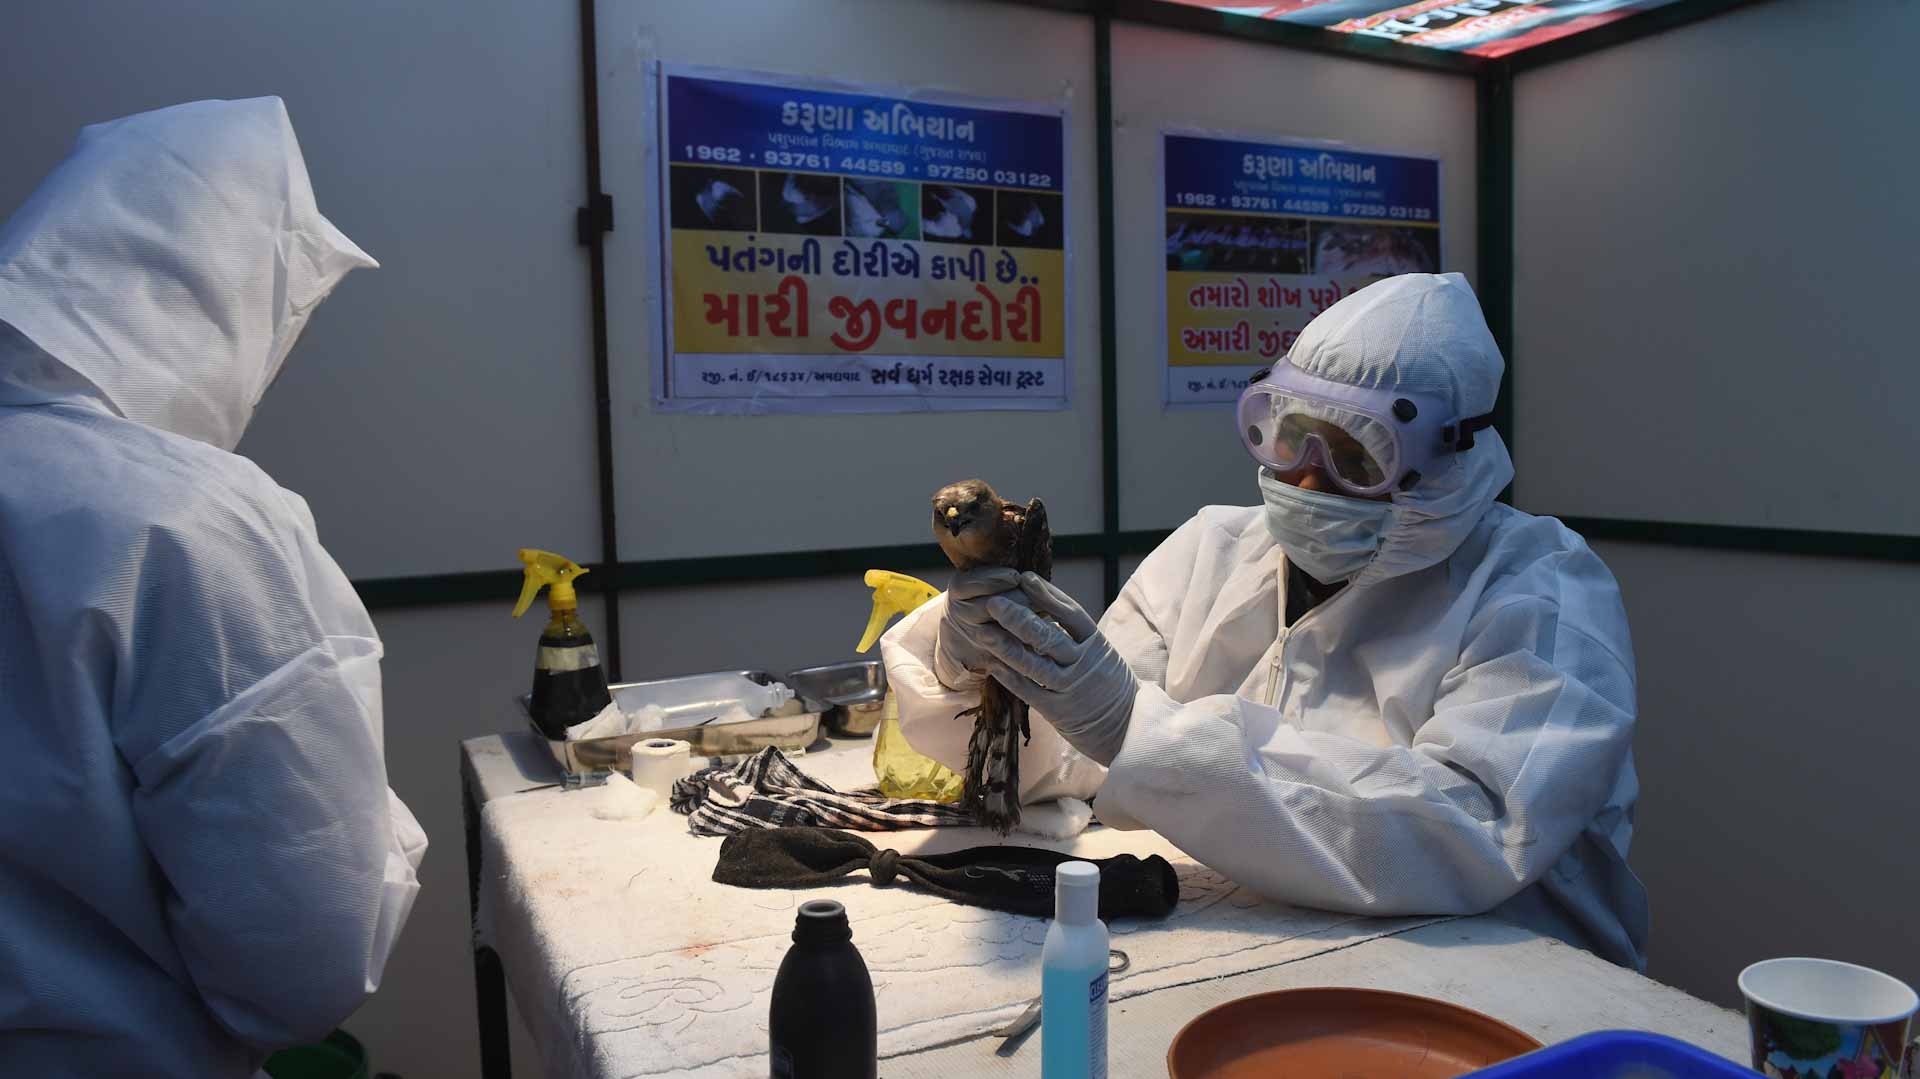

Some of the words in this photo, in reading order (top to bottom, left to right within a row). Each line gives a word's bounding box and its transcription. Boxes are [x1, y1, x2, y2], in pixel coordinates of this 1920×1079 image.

[781, 100, 854, 133] કરૂણા
[864, 103, 975, 142] અભિયાન
[685, 145, 741, 162] 1962
[764, 151, 830, 169] 93761
[840, 157, 906, 175] 44559
[927, 164, 989, 182] 97250
[994, 171, 1052, 188] 03122
[1242, 153, 1294, 180] કરૂણા
[1299, 152, 1377, 184] અભિયાન
[1175, 192, 1217, 206] 1962
[705, 235, 821, 275] પતંગની
[832, 239, 920, 279] દોરીએ
[931, 248, 986, 282] કાપી
[995, 249, 1039, 285] છે..
[1189, 277, 1249, 308] તમારો
[1257, 277, 1302, 308] શોખ
[703, 275, 809, 337] મારી
[828, 283, 1041, 352] જીવનદોરી
[1183, 320, 1251, 352] અમારી
[871, 362, 903, 385] સર્વ
[907, 363, 934, 386] ધર્મ
[977, 365, 1011, 386] સેવા
